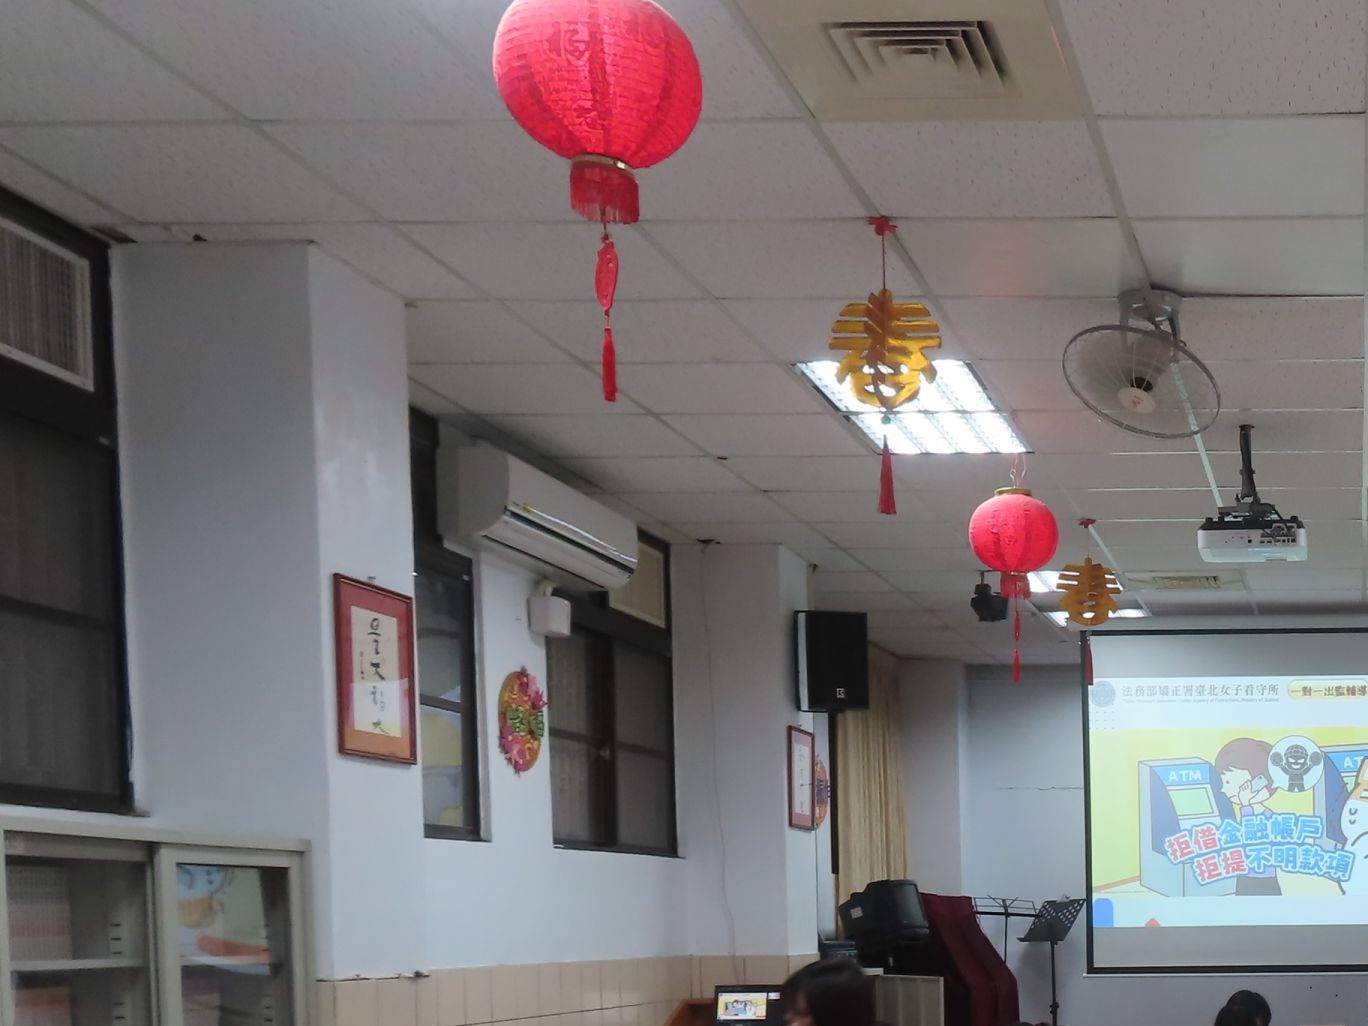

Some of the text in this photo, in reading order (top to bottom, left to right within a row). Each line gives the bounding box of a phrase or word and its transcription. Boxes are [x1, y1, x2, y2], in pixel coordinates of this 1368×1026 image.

[1290, 686, 1368, 698] 一對一出監輔導
[1168, 770, 1202, 782] ATM
[1166, 815, 1321, 861] 拒借金融帳戶
[1194, 846, 1353, 881] 拒提不明款項
